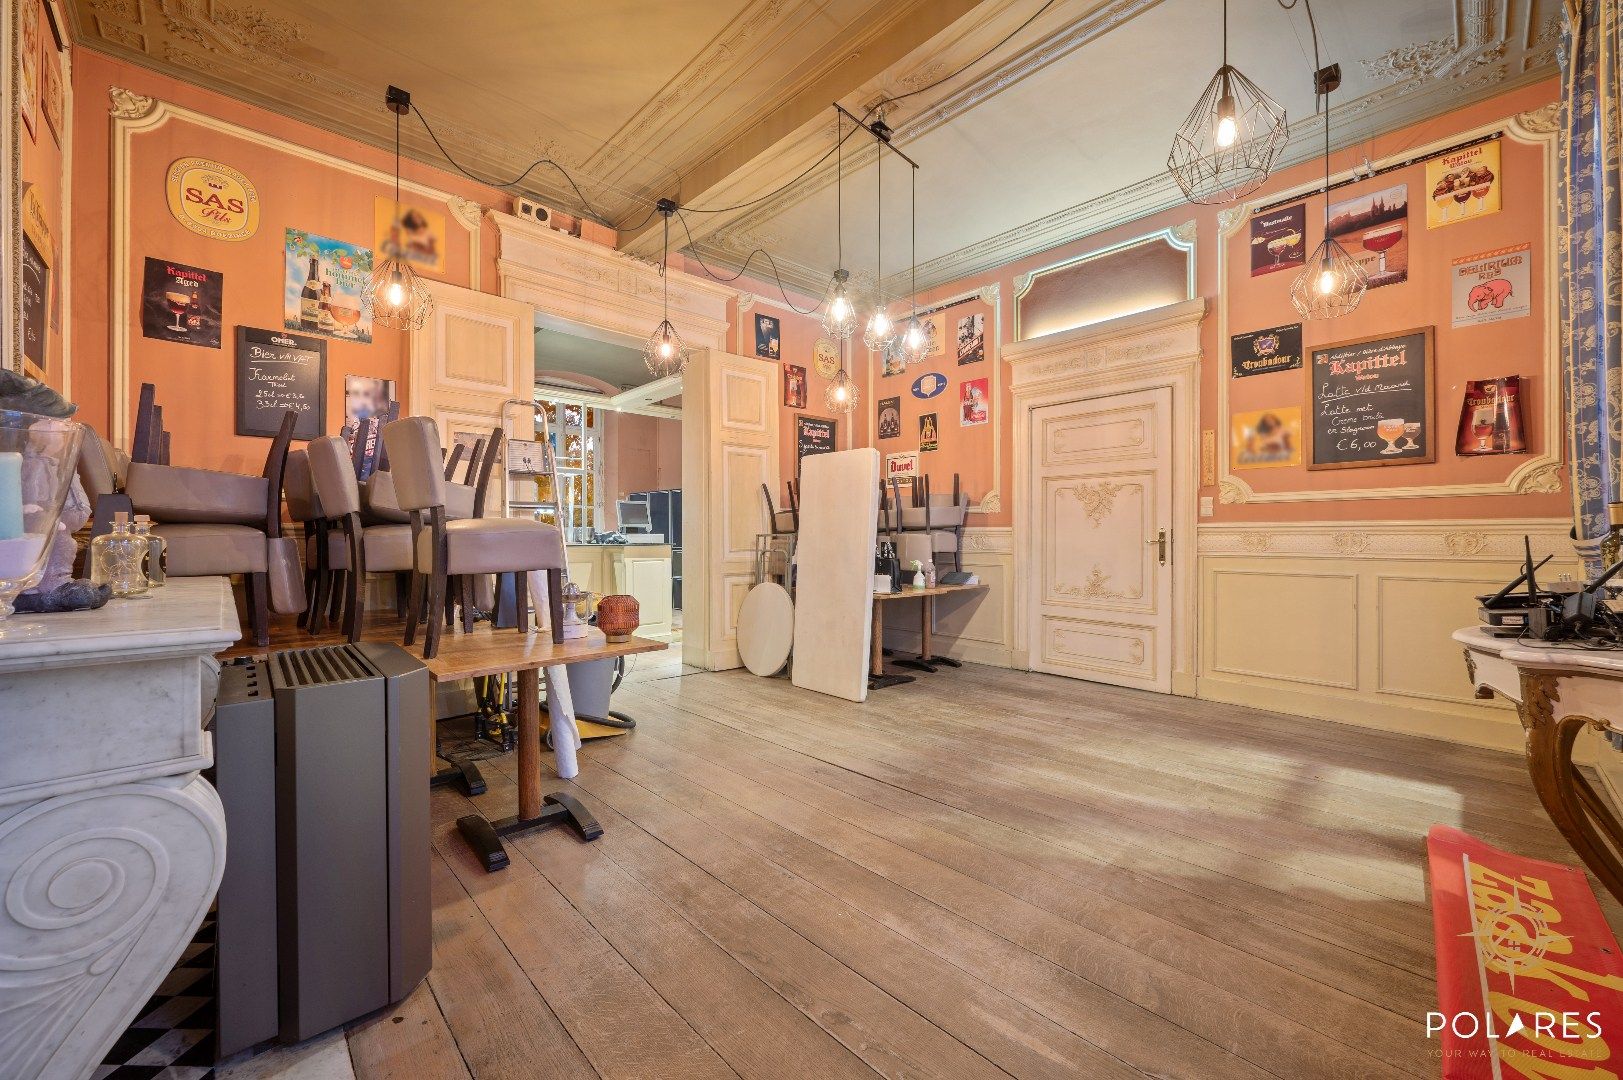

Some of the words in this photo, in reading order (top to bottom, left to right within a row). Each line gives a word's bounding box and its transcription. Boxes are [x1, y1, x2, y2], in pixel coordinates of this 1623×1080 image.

[1442, 147, 1482, 166] Kapittel
[185, 187, 244, 213] SAS
[200, 207, 231, 223] Pils
[166, 266, 208, 282] Kapittel
[1479, 268, 1501, 280] RED
[175, 276, 199, 288] Aged
[250, 346, 276, 359] Bier
[818, 353, 835, 365] SAS
[1242, 355, 1292, 370] Troubadour
[1329, 350, 1408, 376] Kapittel
[1317, 382, 1351, 400] Latte
[1320, 403, 1351, 416] Latte
[1356, 403, 1374, 412] met
[890, 458, 914, 473] Duvel
